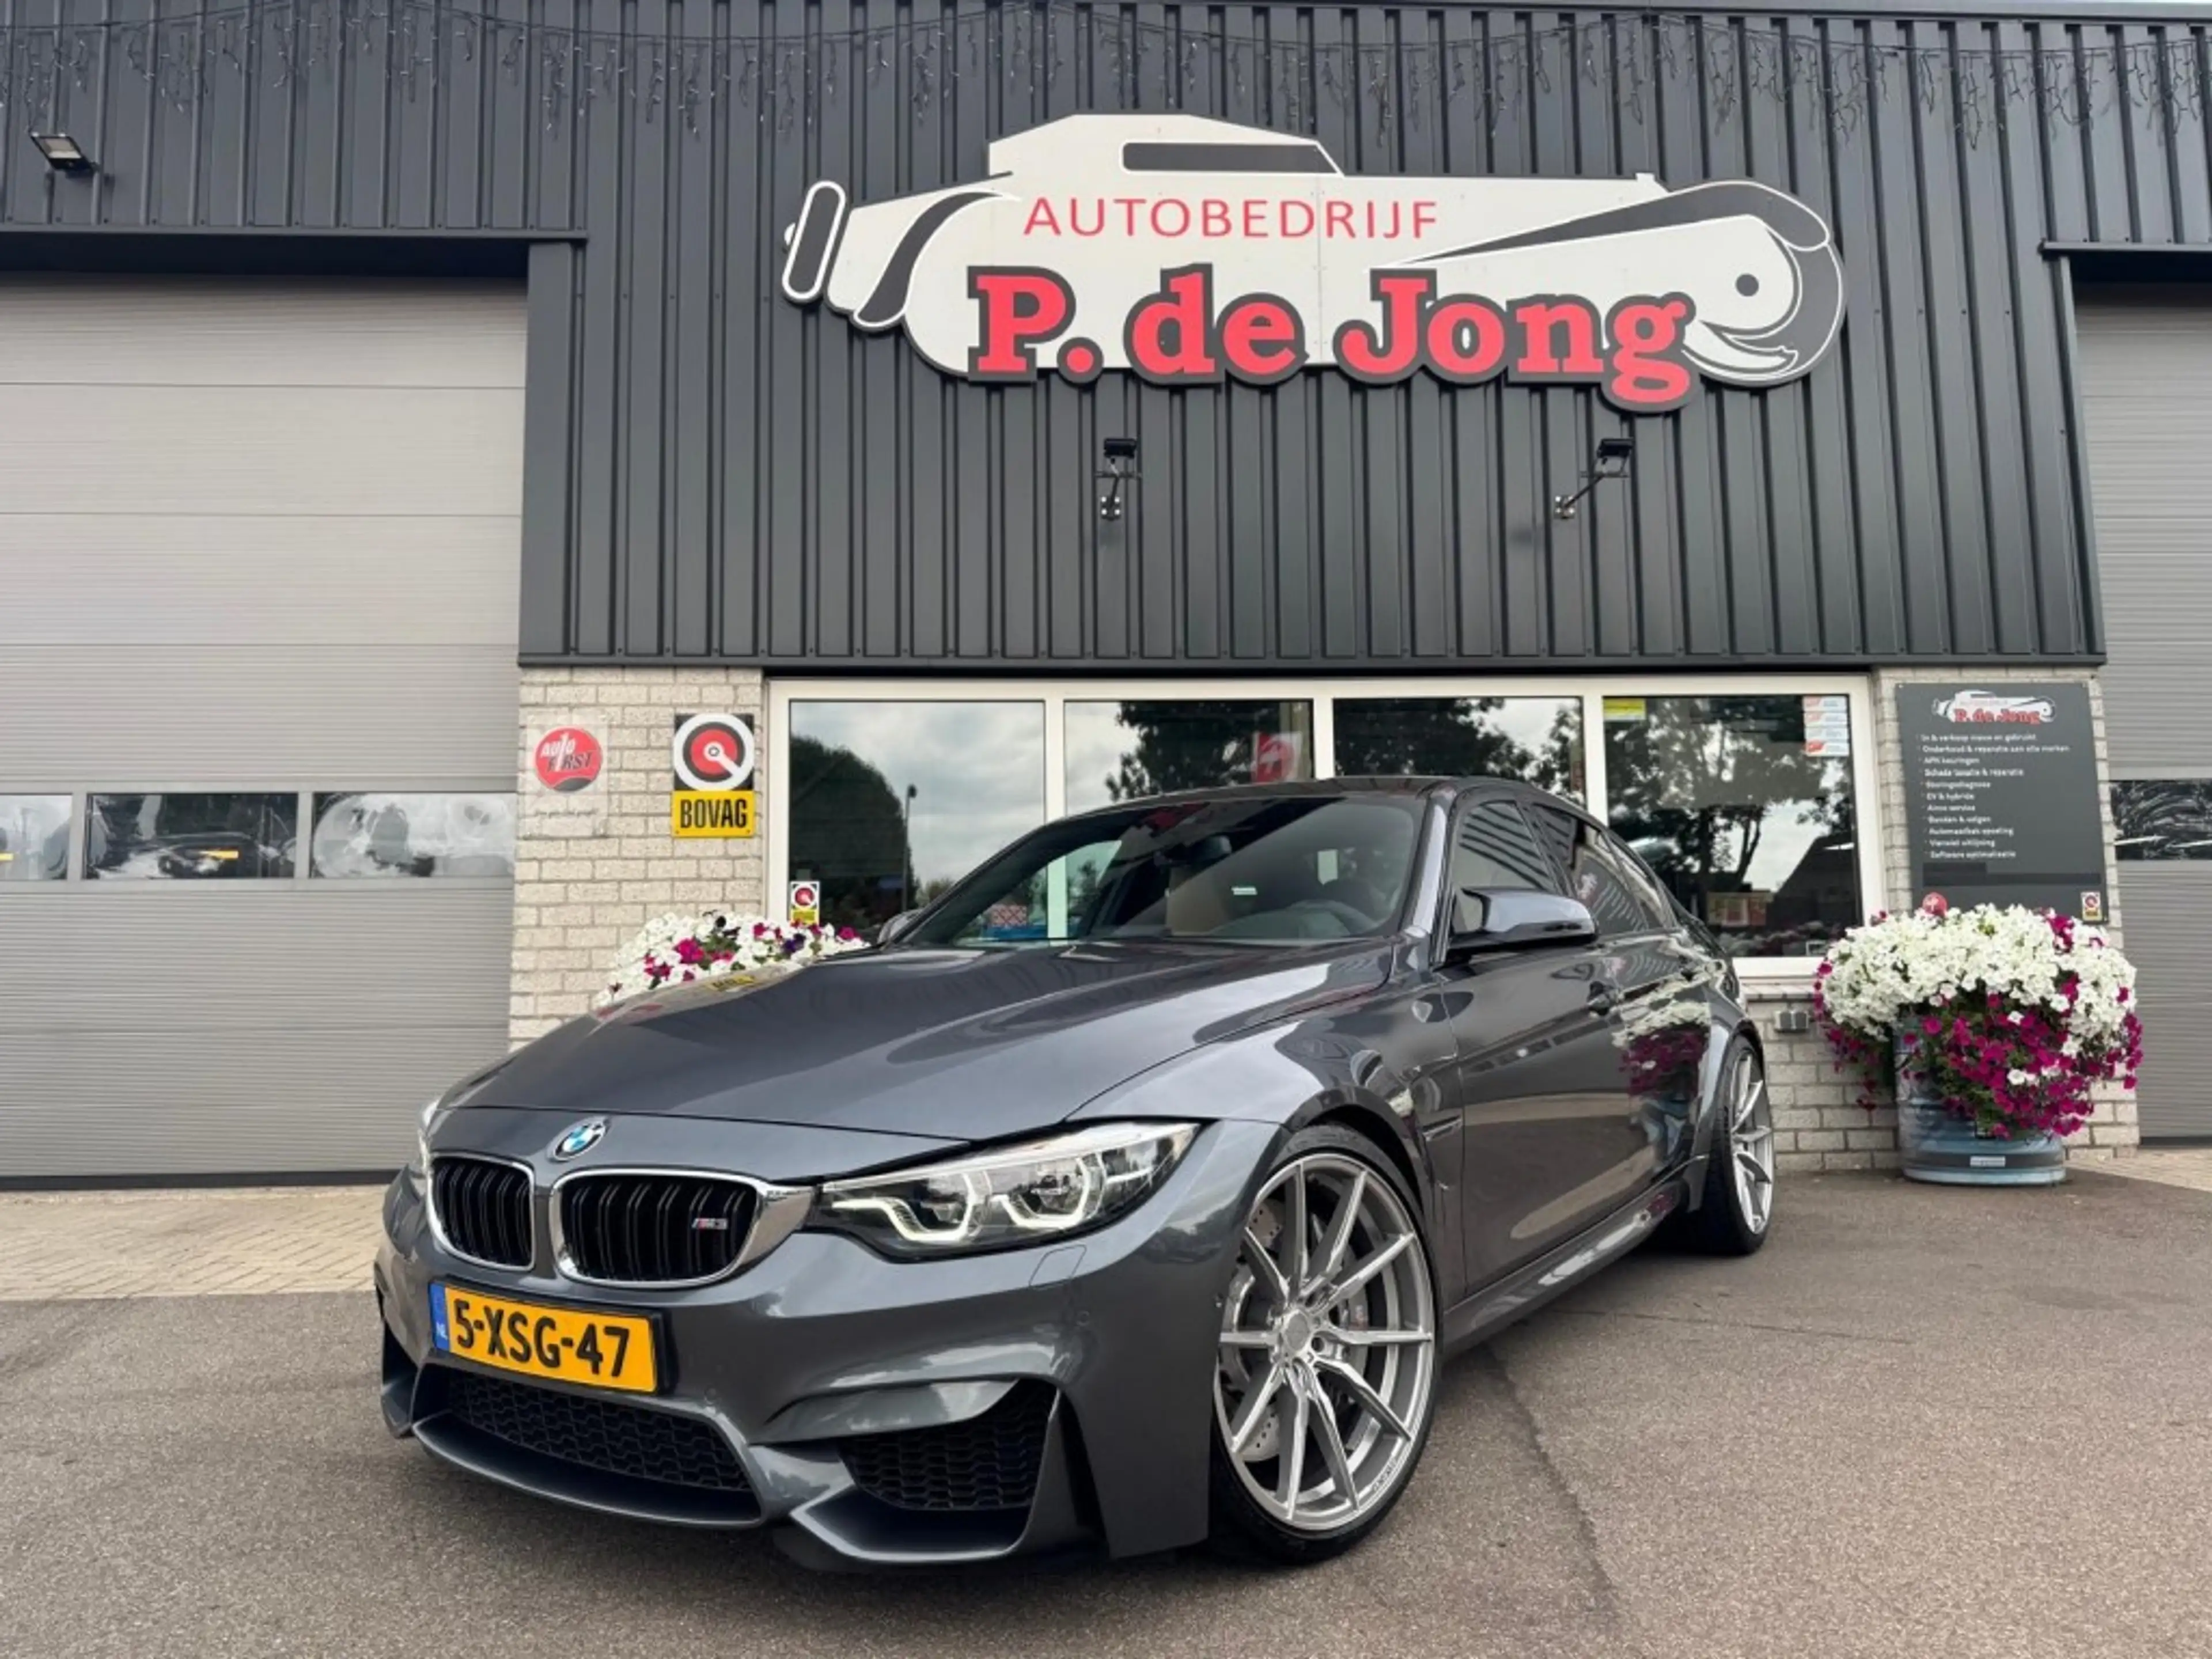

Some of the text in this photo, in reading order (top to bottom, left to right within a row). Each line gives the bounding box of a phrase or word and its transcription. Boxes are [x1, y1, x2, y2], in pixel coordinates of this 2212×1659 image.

[1024, 198, 1438, 237] AUTOBEDRIJF
[975, 271, 1691, 404] P. de Jong
[1998, 709, 2040, 725] Jong
[681, 799, 747, 828] BOVAG
[453, 1298, 630, 1378] 5-XSG-47
